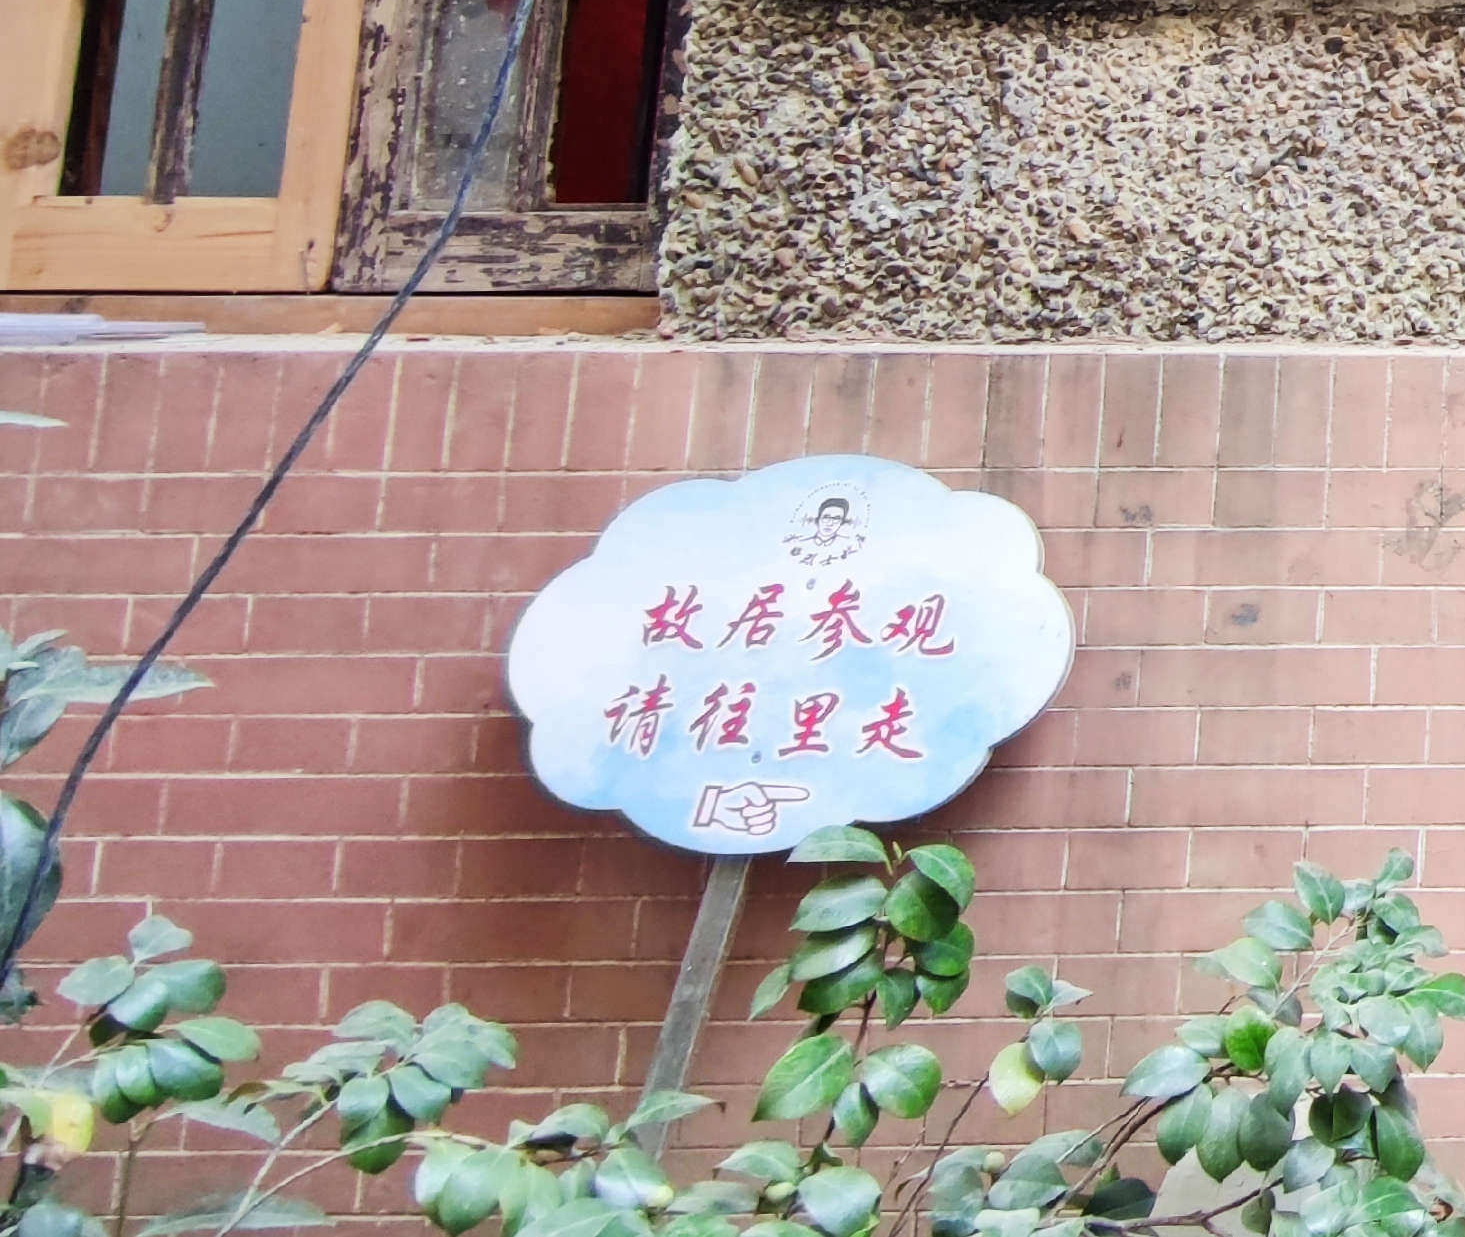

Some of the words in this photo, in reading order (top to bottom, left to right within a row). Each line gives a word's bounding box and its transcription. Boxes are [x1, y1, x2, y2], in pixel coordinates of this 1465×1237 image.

[642, 578, 955, 661] 故居参观
[603, 674, 924, 759] 请往里走
